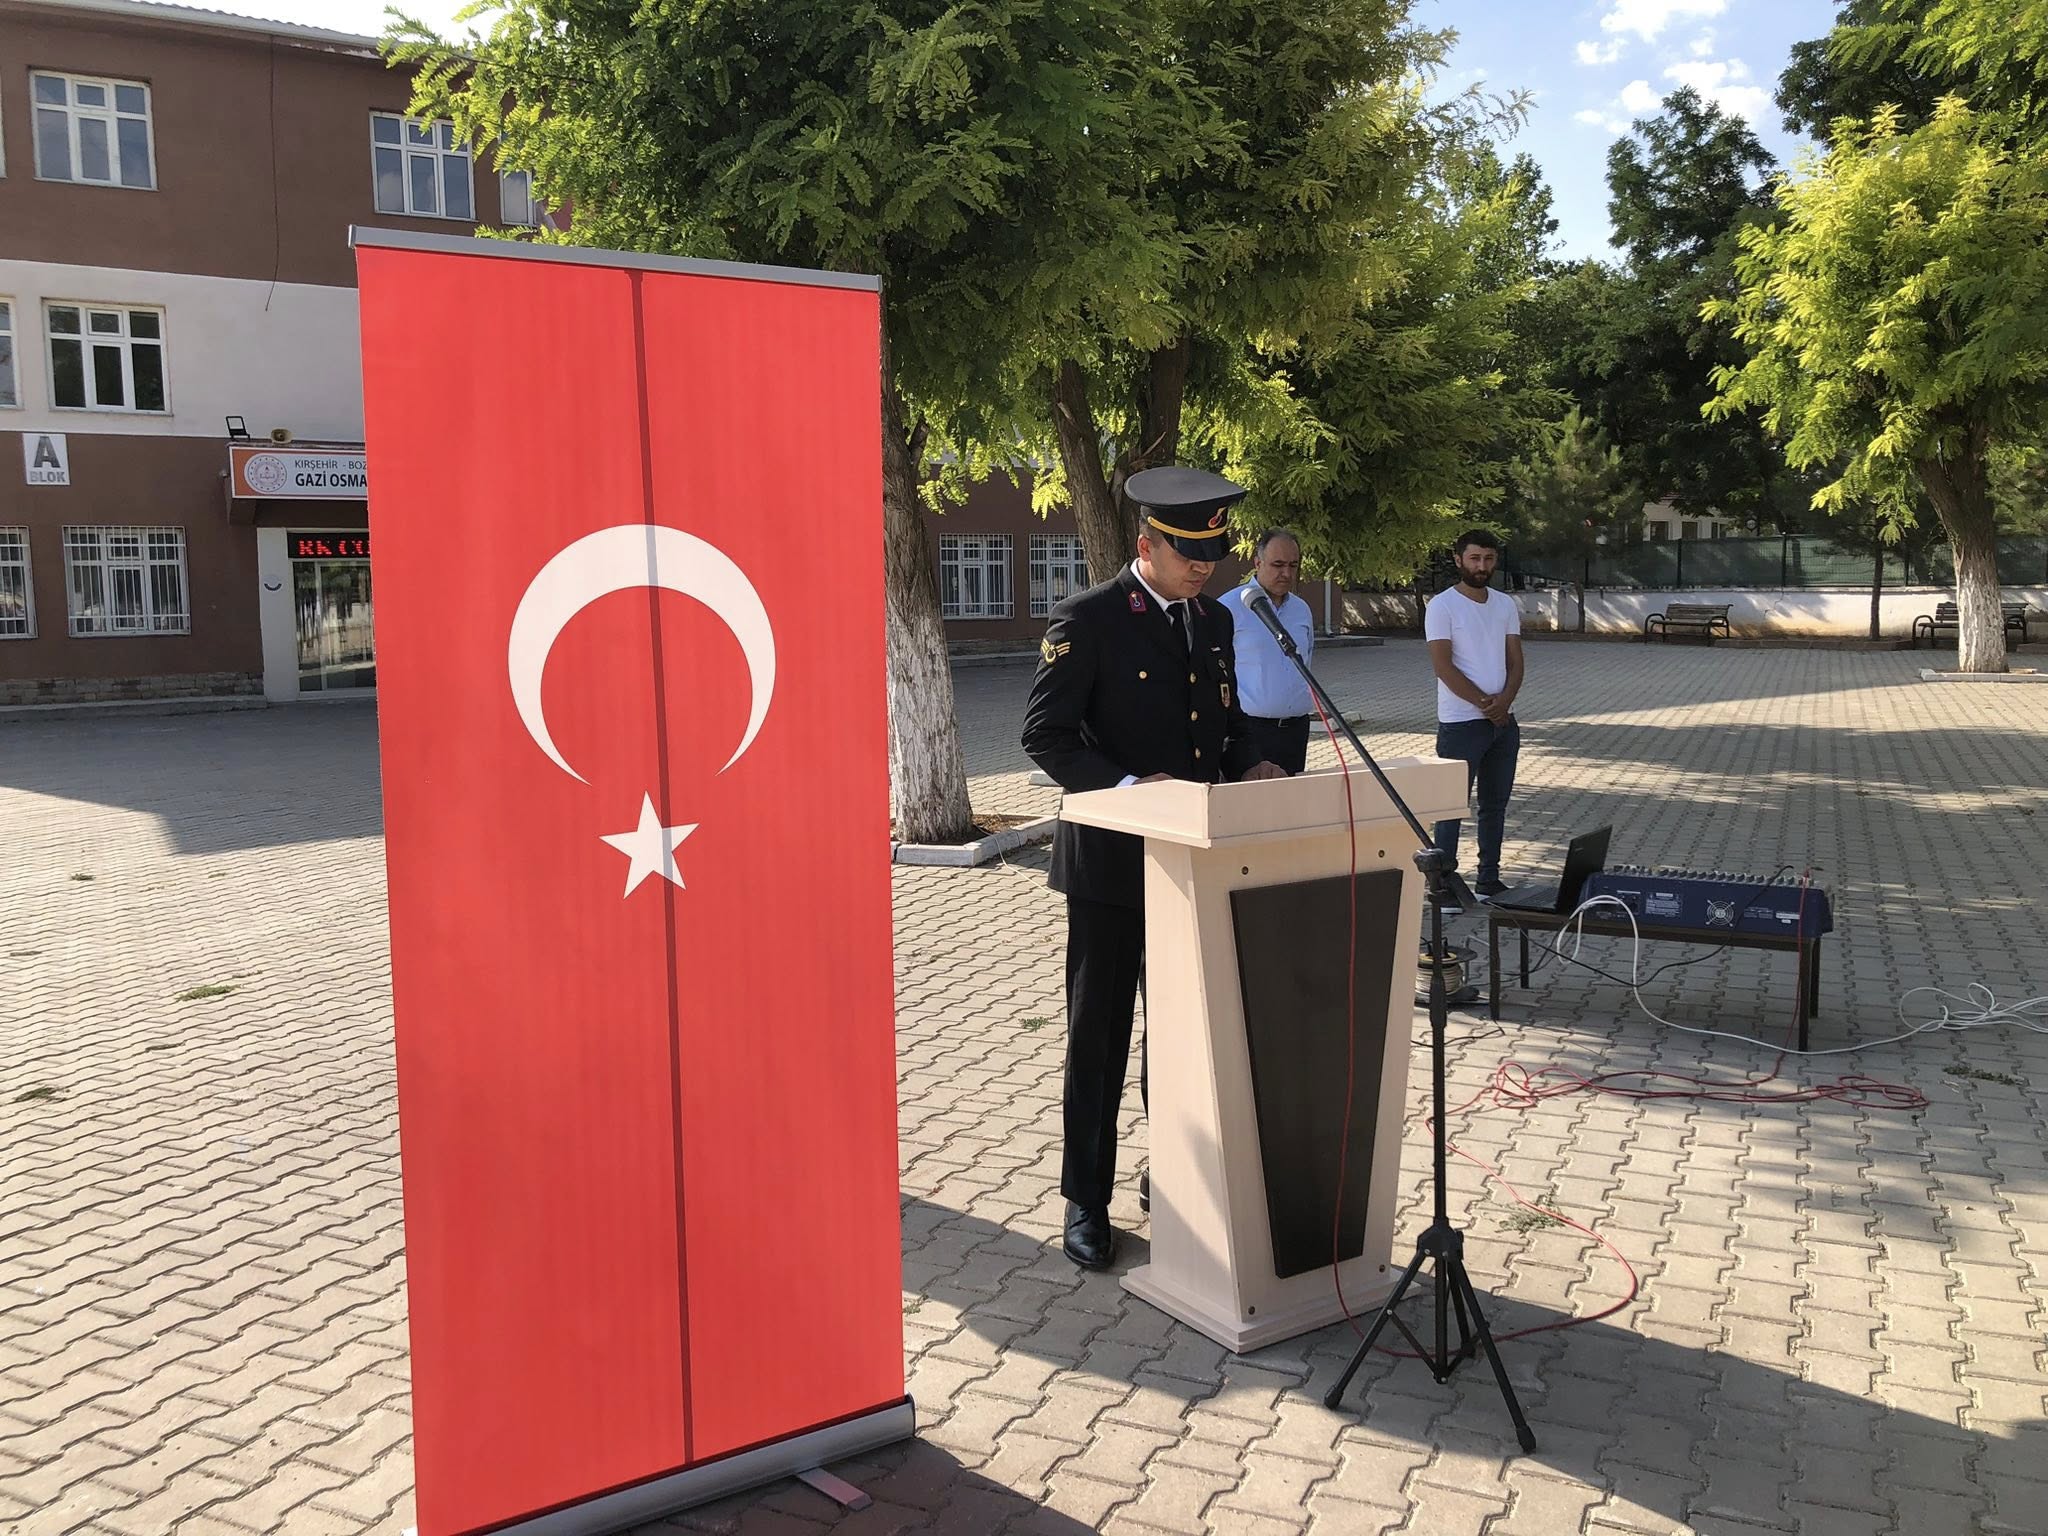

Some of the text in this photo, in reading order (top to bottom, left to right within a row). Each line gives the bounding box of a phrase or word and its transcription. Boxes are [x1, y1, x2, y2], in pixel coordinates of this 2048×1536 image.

[33, 436, 61, 468] A
[294, 459, 338, 471] KIRŞEHİR
[30, 471, 66, 482] BLOK
[295, 470, 368, 487] GAZİ OSMA
